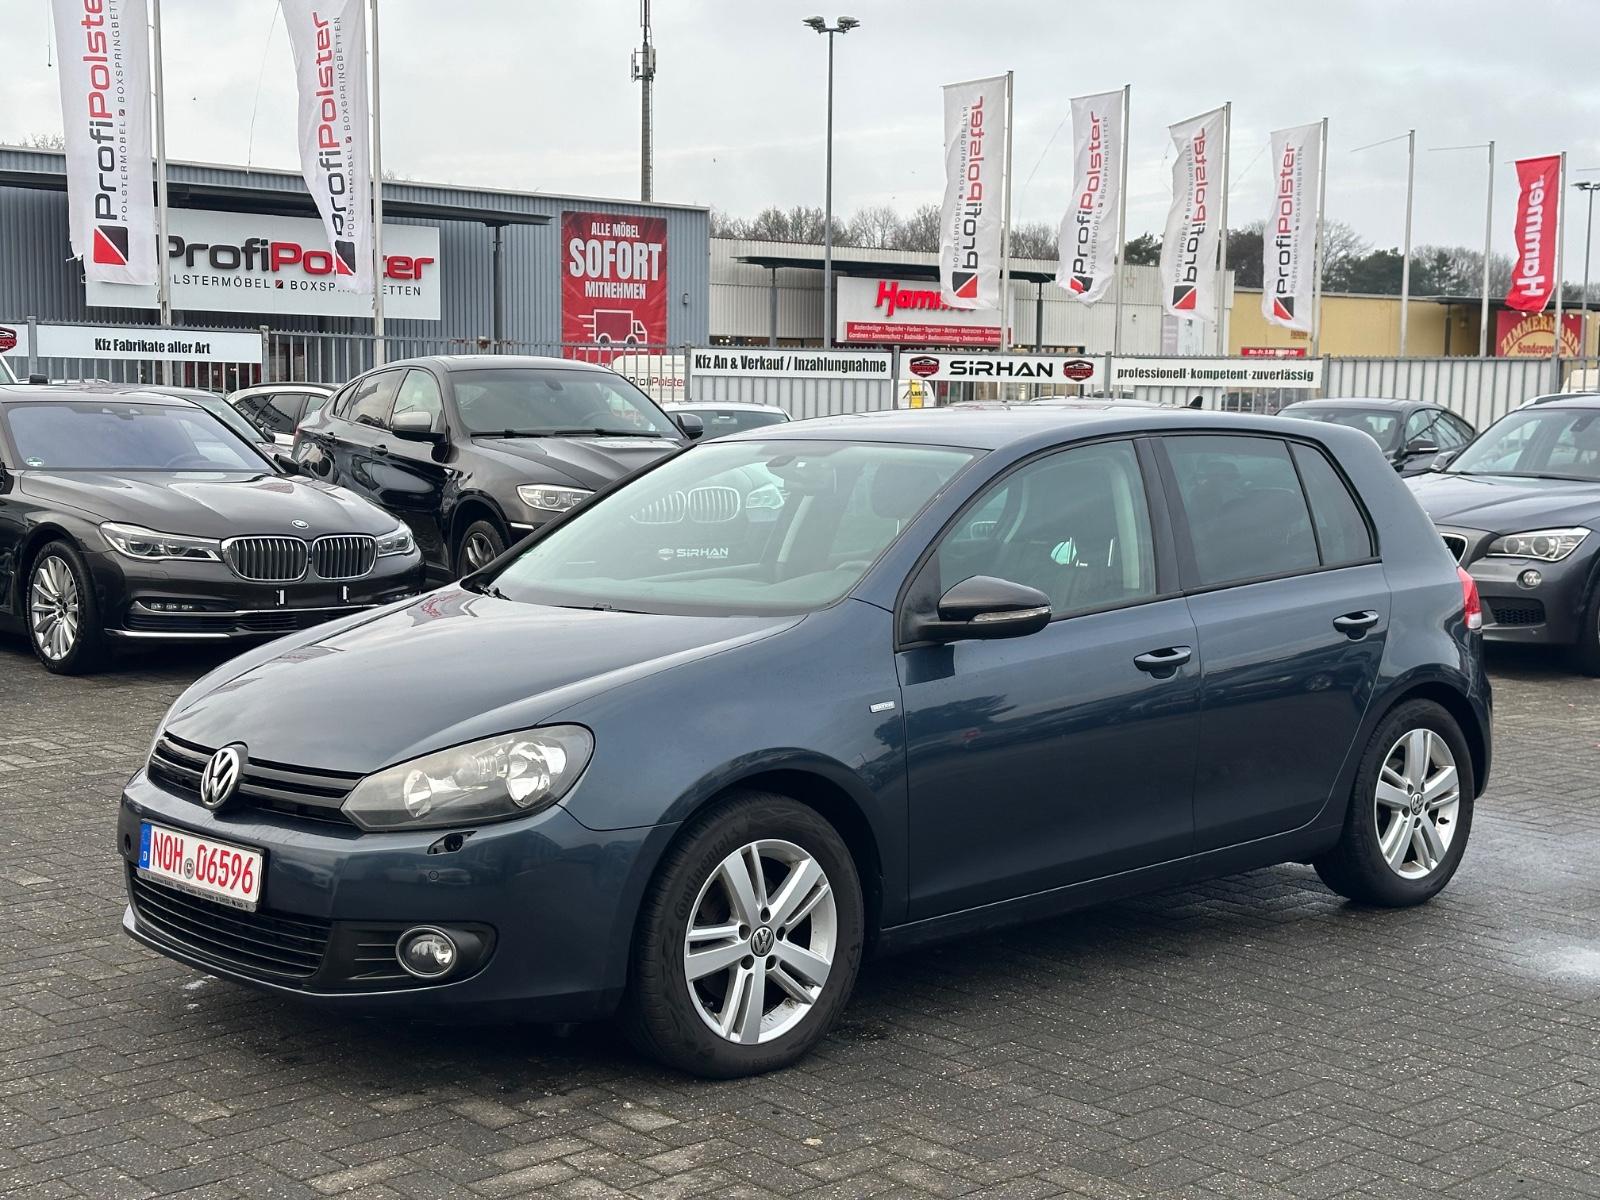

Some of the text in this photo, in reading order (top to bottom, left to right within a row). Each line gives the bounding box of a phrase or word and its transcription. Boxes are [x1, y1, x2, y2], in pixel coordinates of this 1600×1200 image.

[333, 17, 351, 131] BOXSPRINGBETTEN
[312, 12, 347, 235] ProfiPolster
[1072, 110, 1101, 274] ProfiPolster
[591, 222, 640, 238] ALLE MÖBEL
[1276, 142, 1295, 294] ProfiPolster
[156, 234, 435, 281] ProfiPoer
[569, 238, 662, 281] SOFORT
[174, 274, 271, 290] LSTERMÖBEL
[585, 281, 646, 299] MITNEHMEN
[95, 338, 211, 354] Kfz Fabrikate aller Art
[1501, 314, 1580, 356] ZIMMERMNN
[695, 354, 886, 373] Kfz An & Verkauf / Inzahlungnahme
[143, 851, 148, 861] D
[152, 831, 184, 875] NOH
[195, 844, 254, 894] 06596
